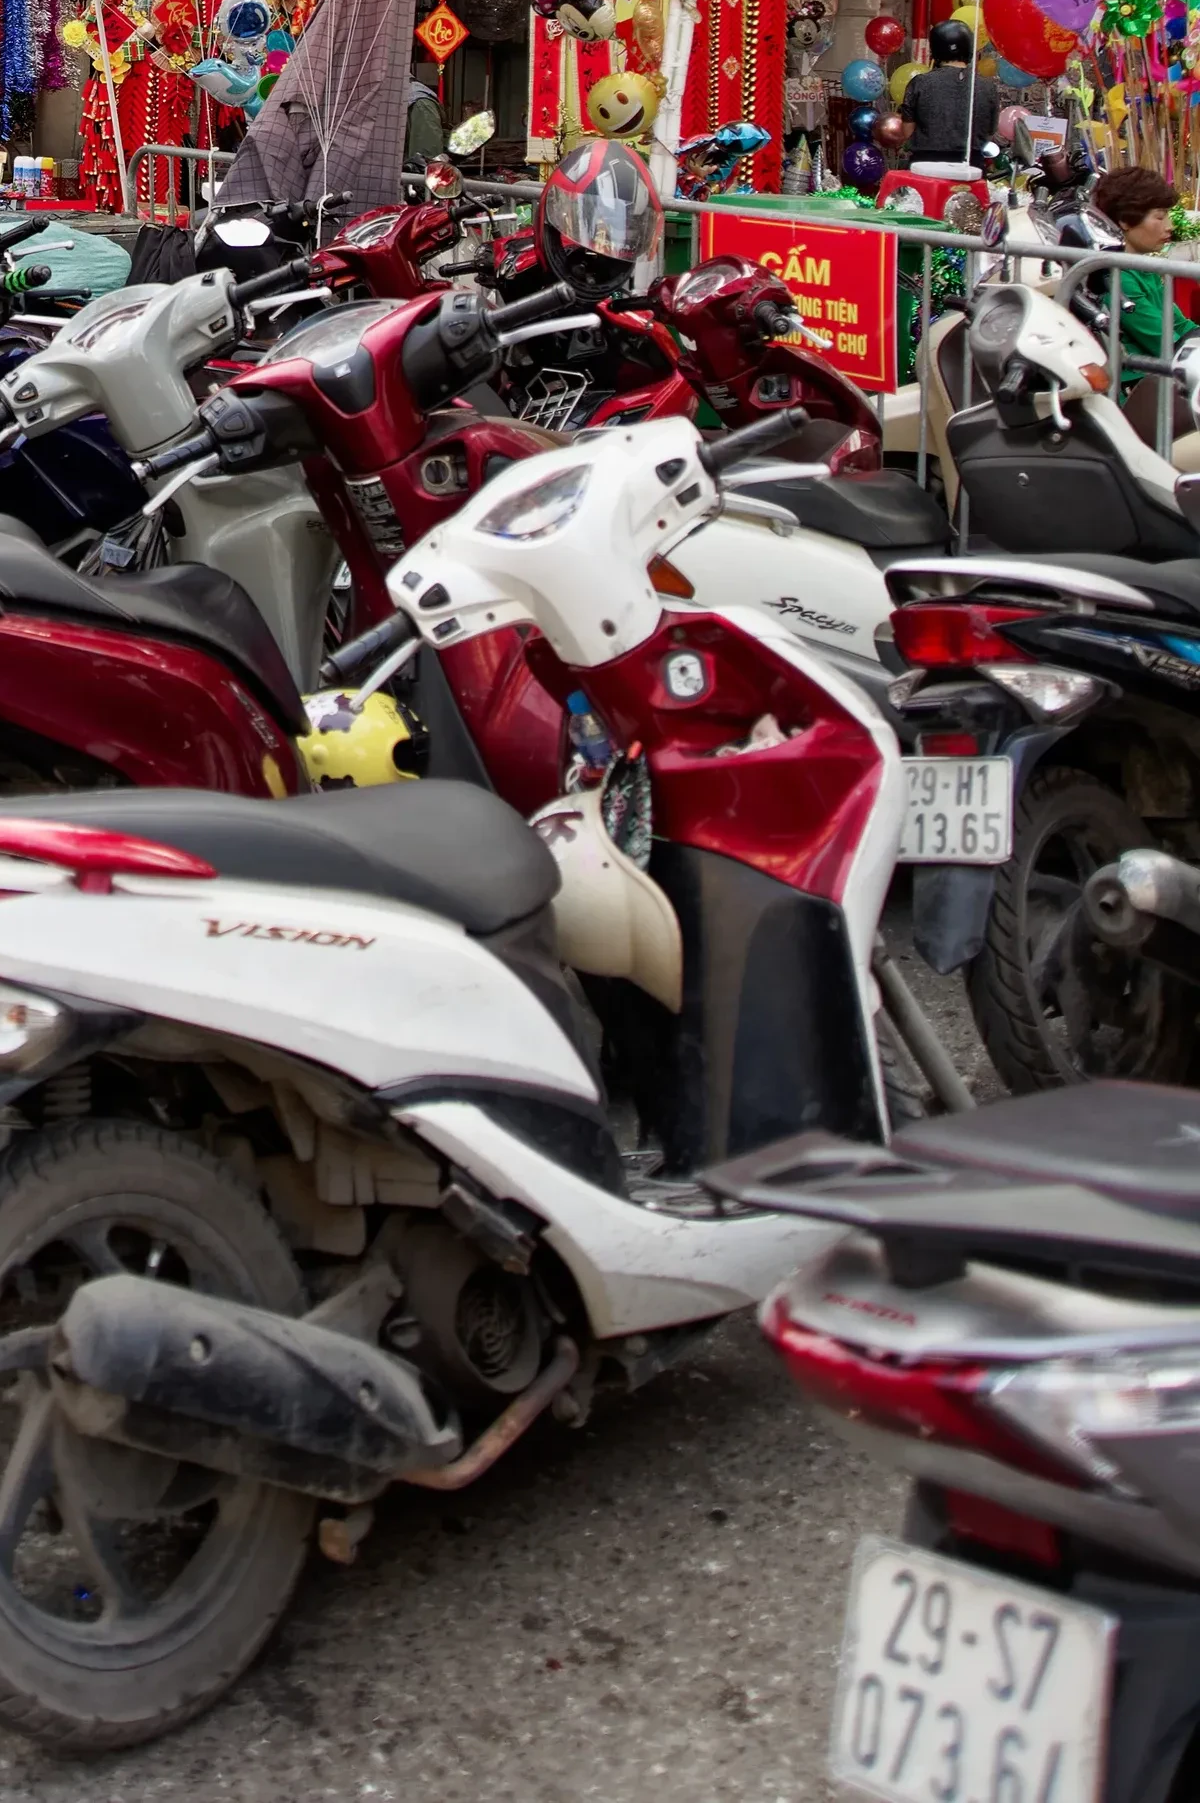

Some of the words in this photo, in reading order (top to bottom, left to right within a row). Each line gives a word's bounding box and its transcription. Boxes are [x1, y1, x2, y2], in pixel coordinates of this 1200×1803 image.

[760, 244, 831, 286] CẤM
[825, 297, 859, 327] TIỆN
[837, 332, 868, 360] CHỢ
[898, 812, 1002, 855] 13.65
[201, 917, 377, 951] VISION
[882, 1568, 1061, 1713] 29-S7
